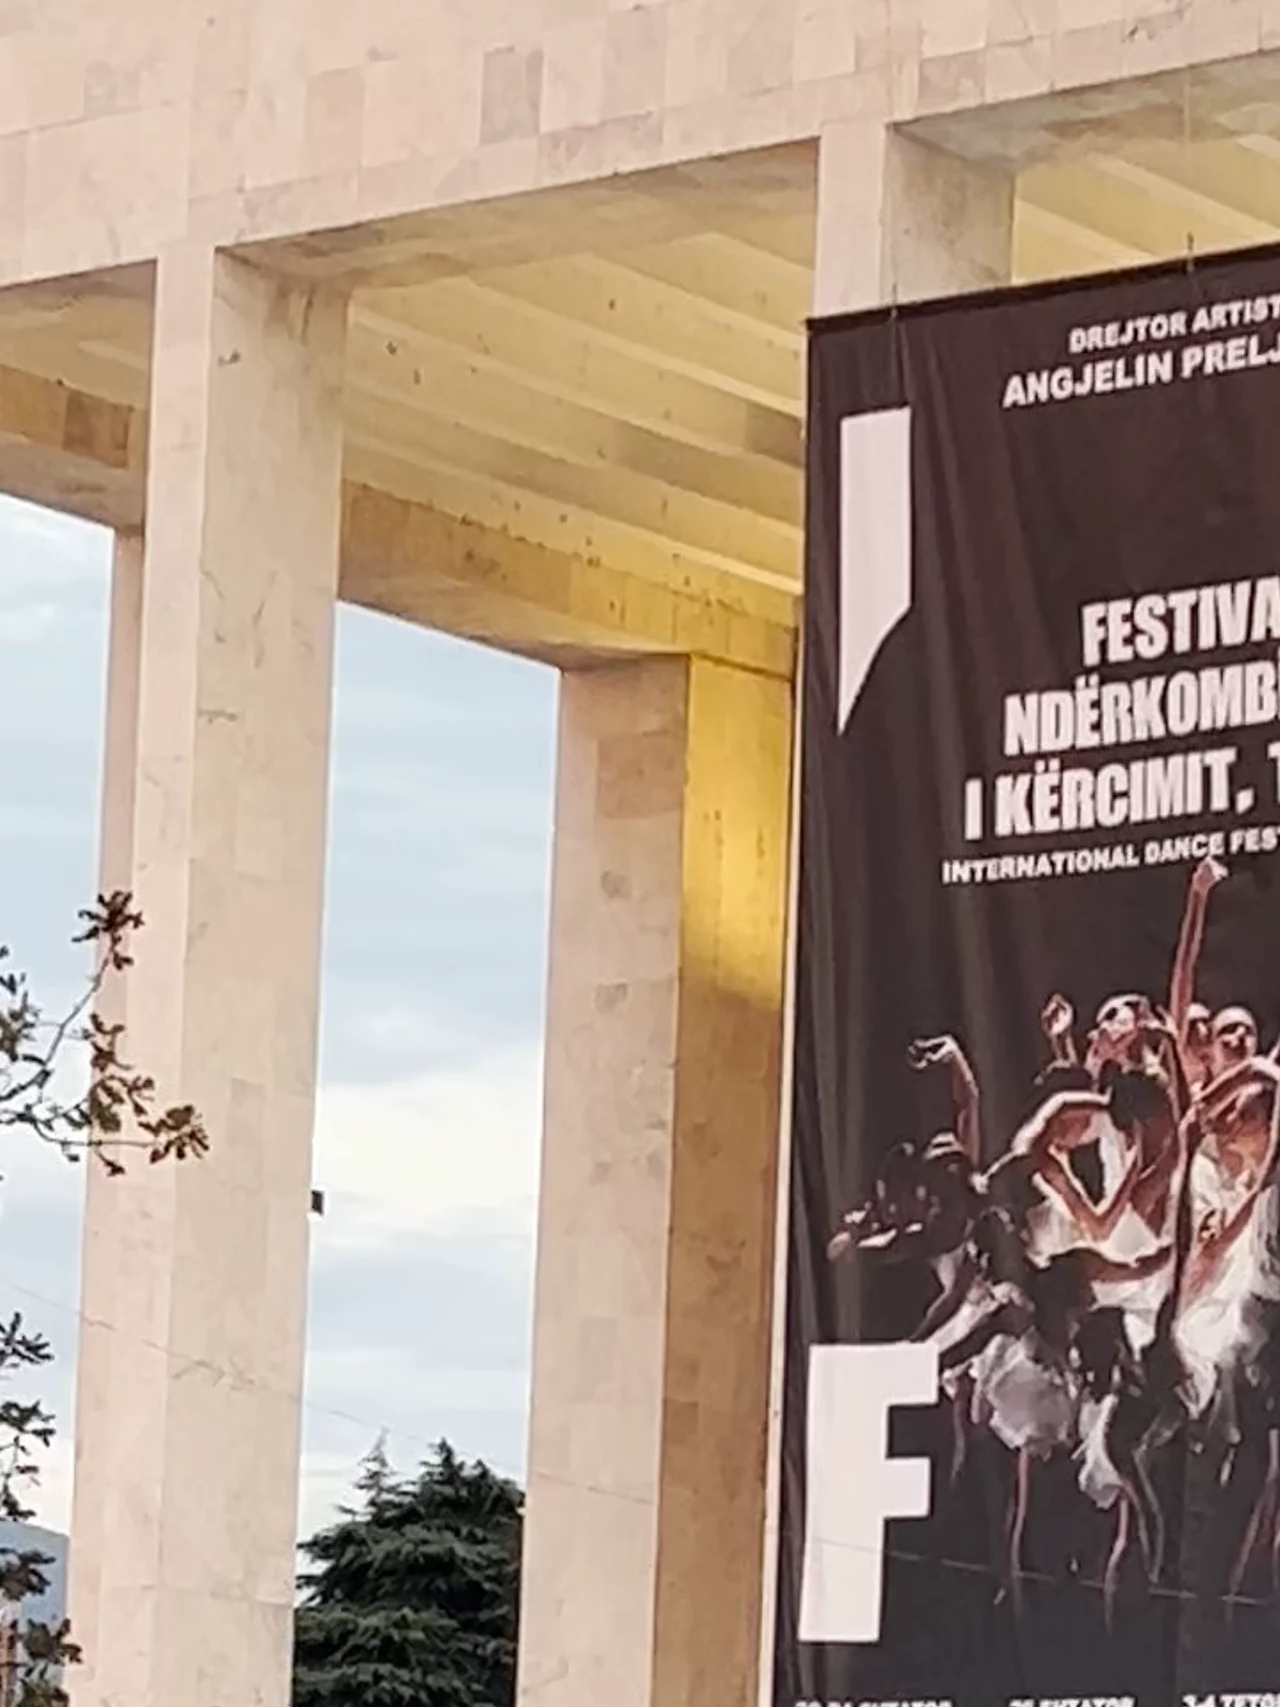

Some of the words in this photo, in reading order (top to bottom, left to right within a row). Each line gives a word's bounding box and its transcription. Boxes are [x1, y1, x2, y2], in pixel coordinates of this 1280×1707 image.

[1069, 311, 1187, 354] DREJTOR
[1001, 349, 1174, 409] ANGJELIN
[964, 777, 983, 841] I
[995, 746, 1255, 837] KËRCIMIT,
[942, 844, 1140, 884] INTERNATIONAL
[1144, 832, 1225, 864] DANCE
[797, 1339, 941, 1643] F
